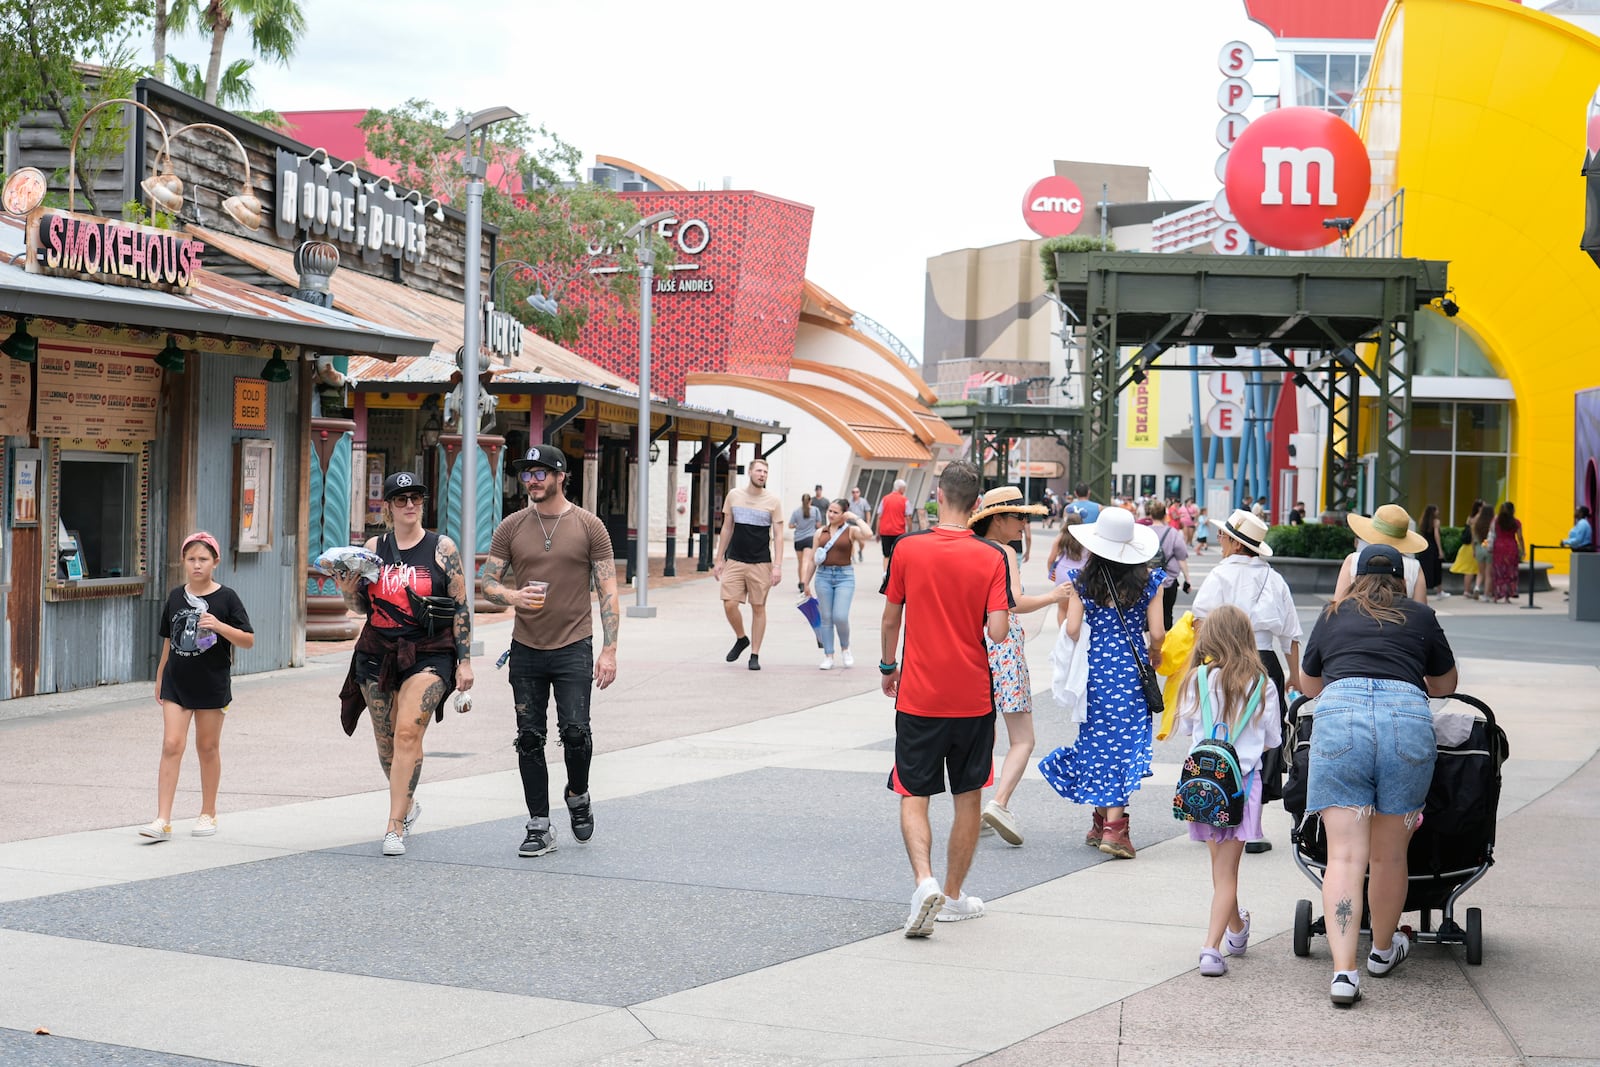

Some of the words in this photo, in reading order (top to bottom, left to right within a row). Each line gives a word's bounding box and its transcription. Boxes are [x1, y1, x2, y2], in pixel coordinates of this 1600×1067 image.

[1260, 147, 1338, 206] m
[281, 170, 356, 232] HOUSE
[367, 205, 427, 258] BLUES
[1031, 195, 1082, 214] amc
[44, 214, 204, 288] SMOKEHOUSE
[678, 278, 714, 292] ANDRÉS
[242, 389, 260, 401] COLD
[241, 406, 260, 418] BEER
